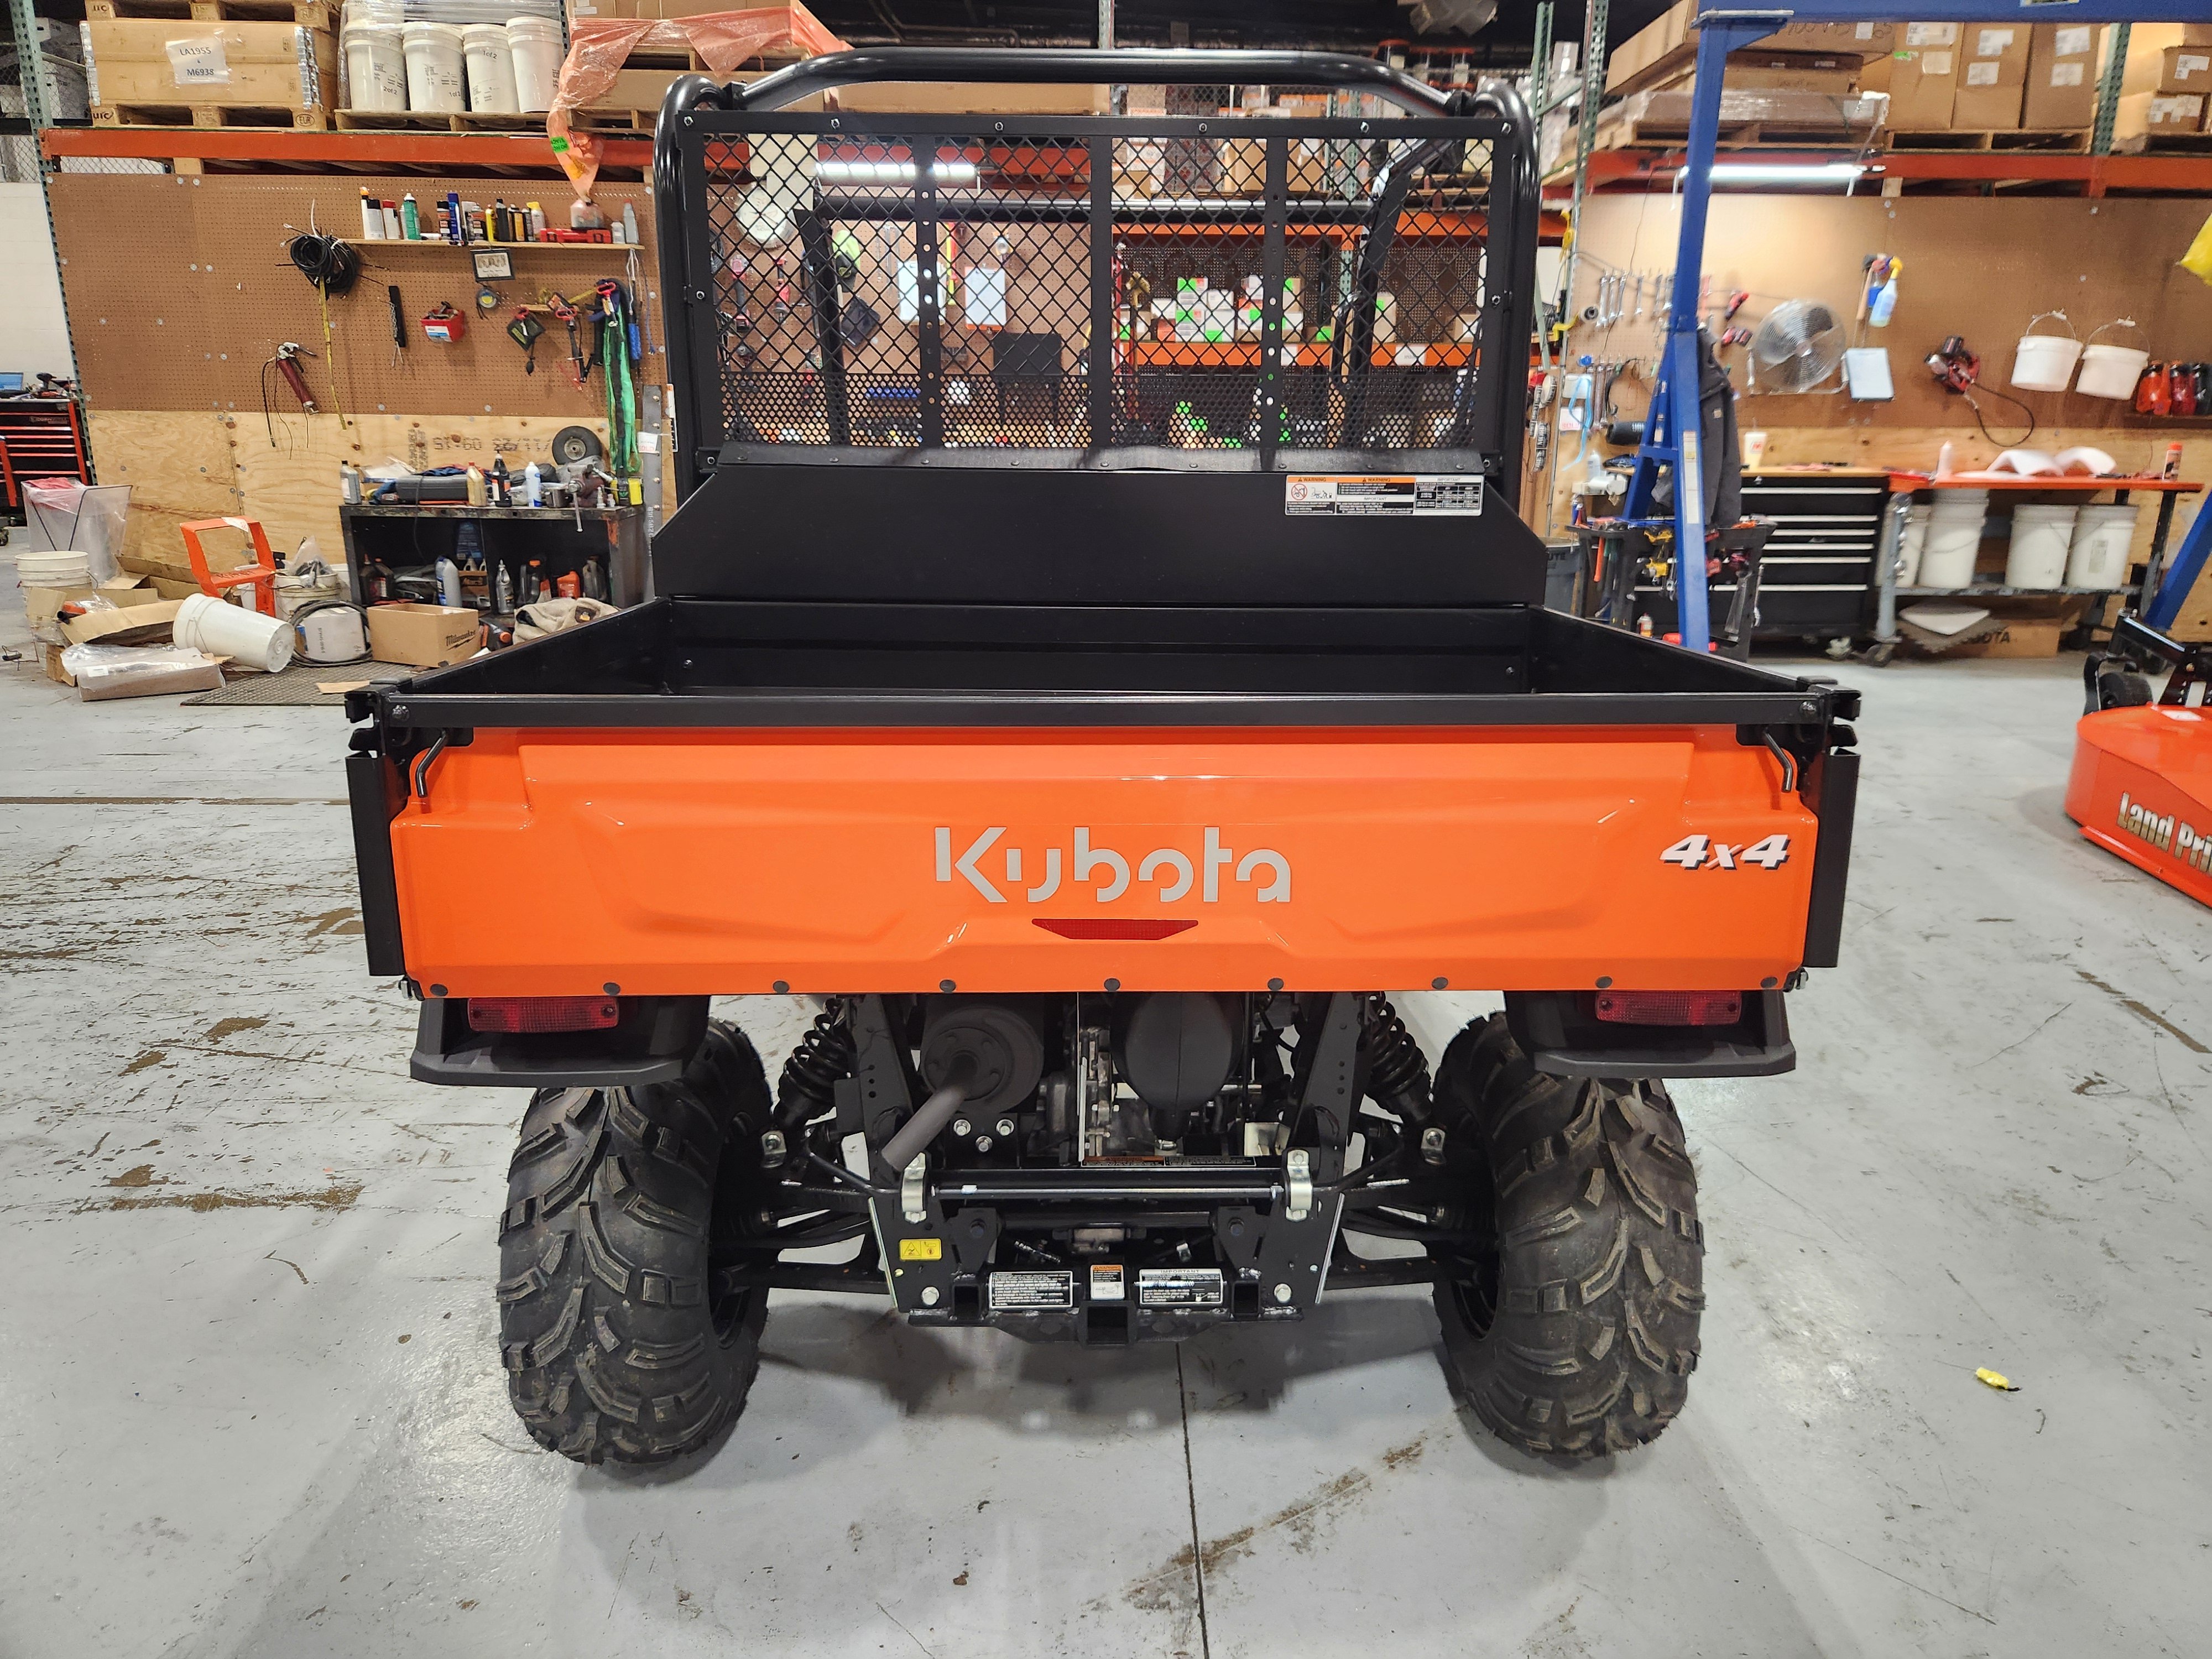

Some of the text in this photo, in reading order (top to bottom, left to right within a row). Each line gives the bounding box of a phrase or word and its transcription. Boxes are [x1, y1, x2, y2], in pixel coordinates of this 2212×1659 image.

[180, 47, 211, 55] LA1955
[299, 116, 311, 124] EUR
[2117, 791, 2212, 874] Land Pri
[935, 827, 1291, 902] Kubota
[1660, 834, 1791, 870] 4x4
